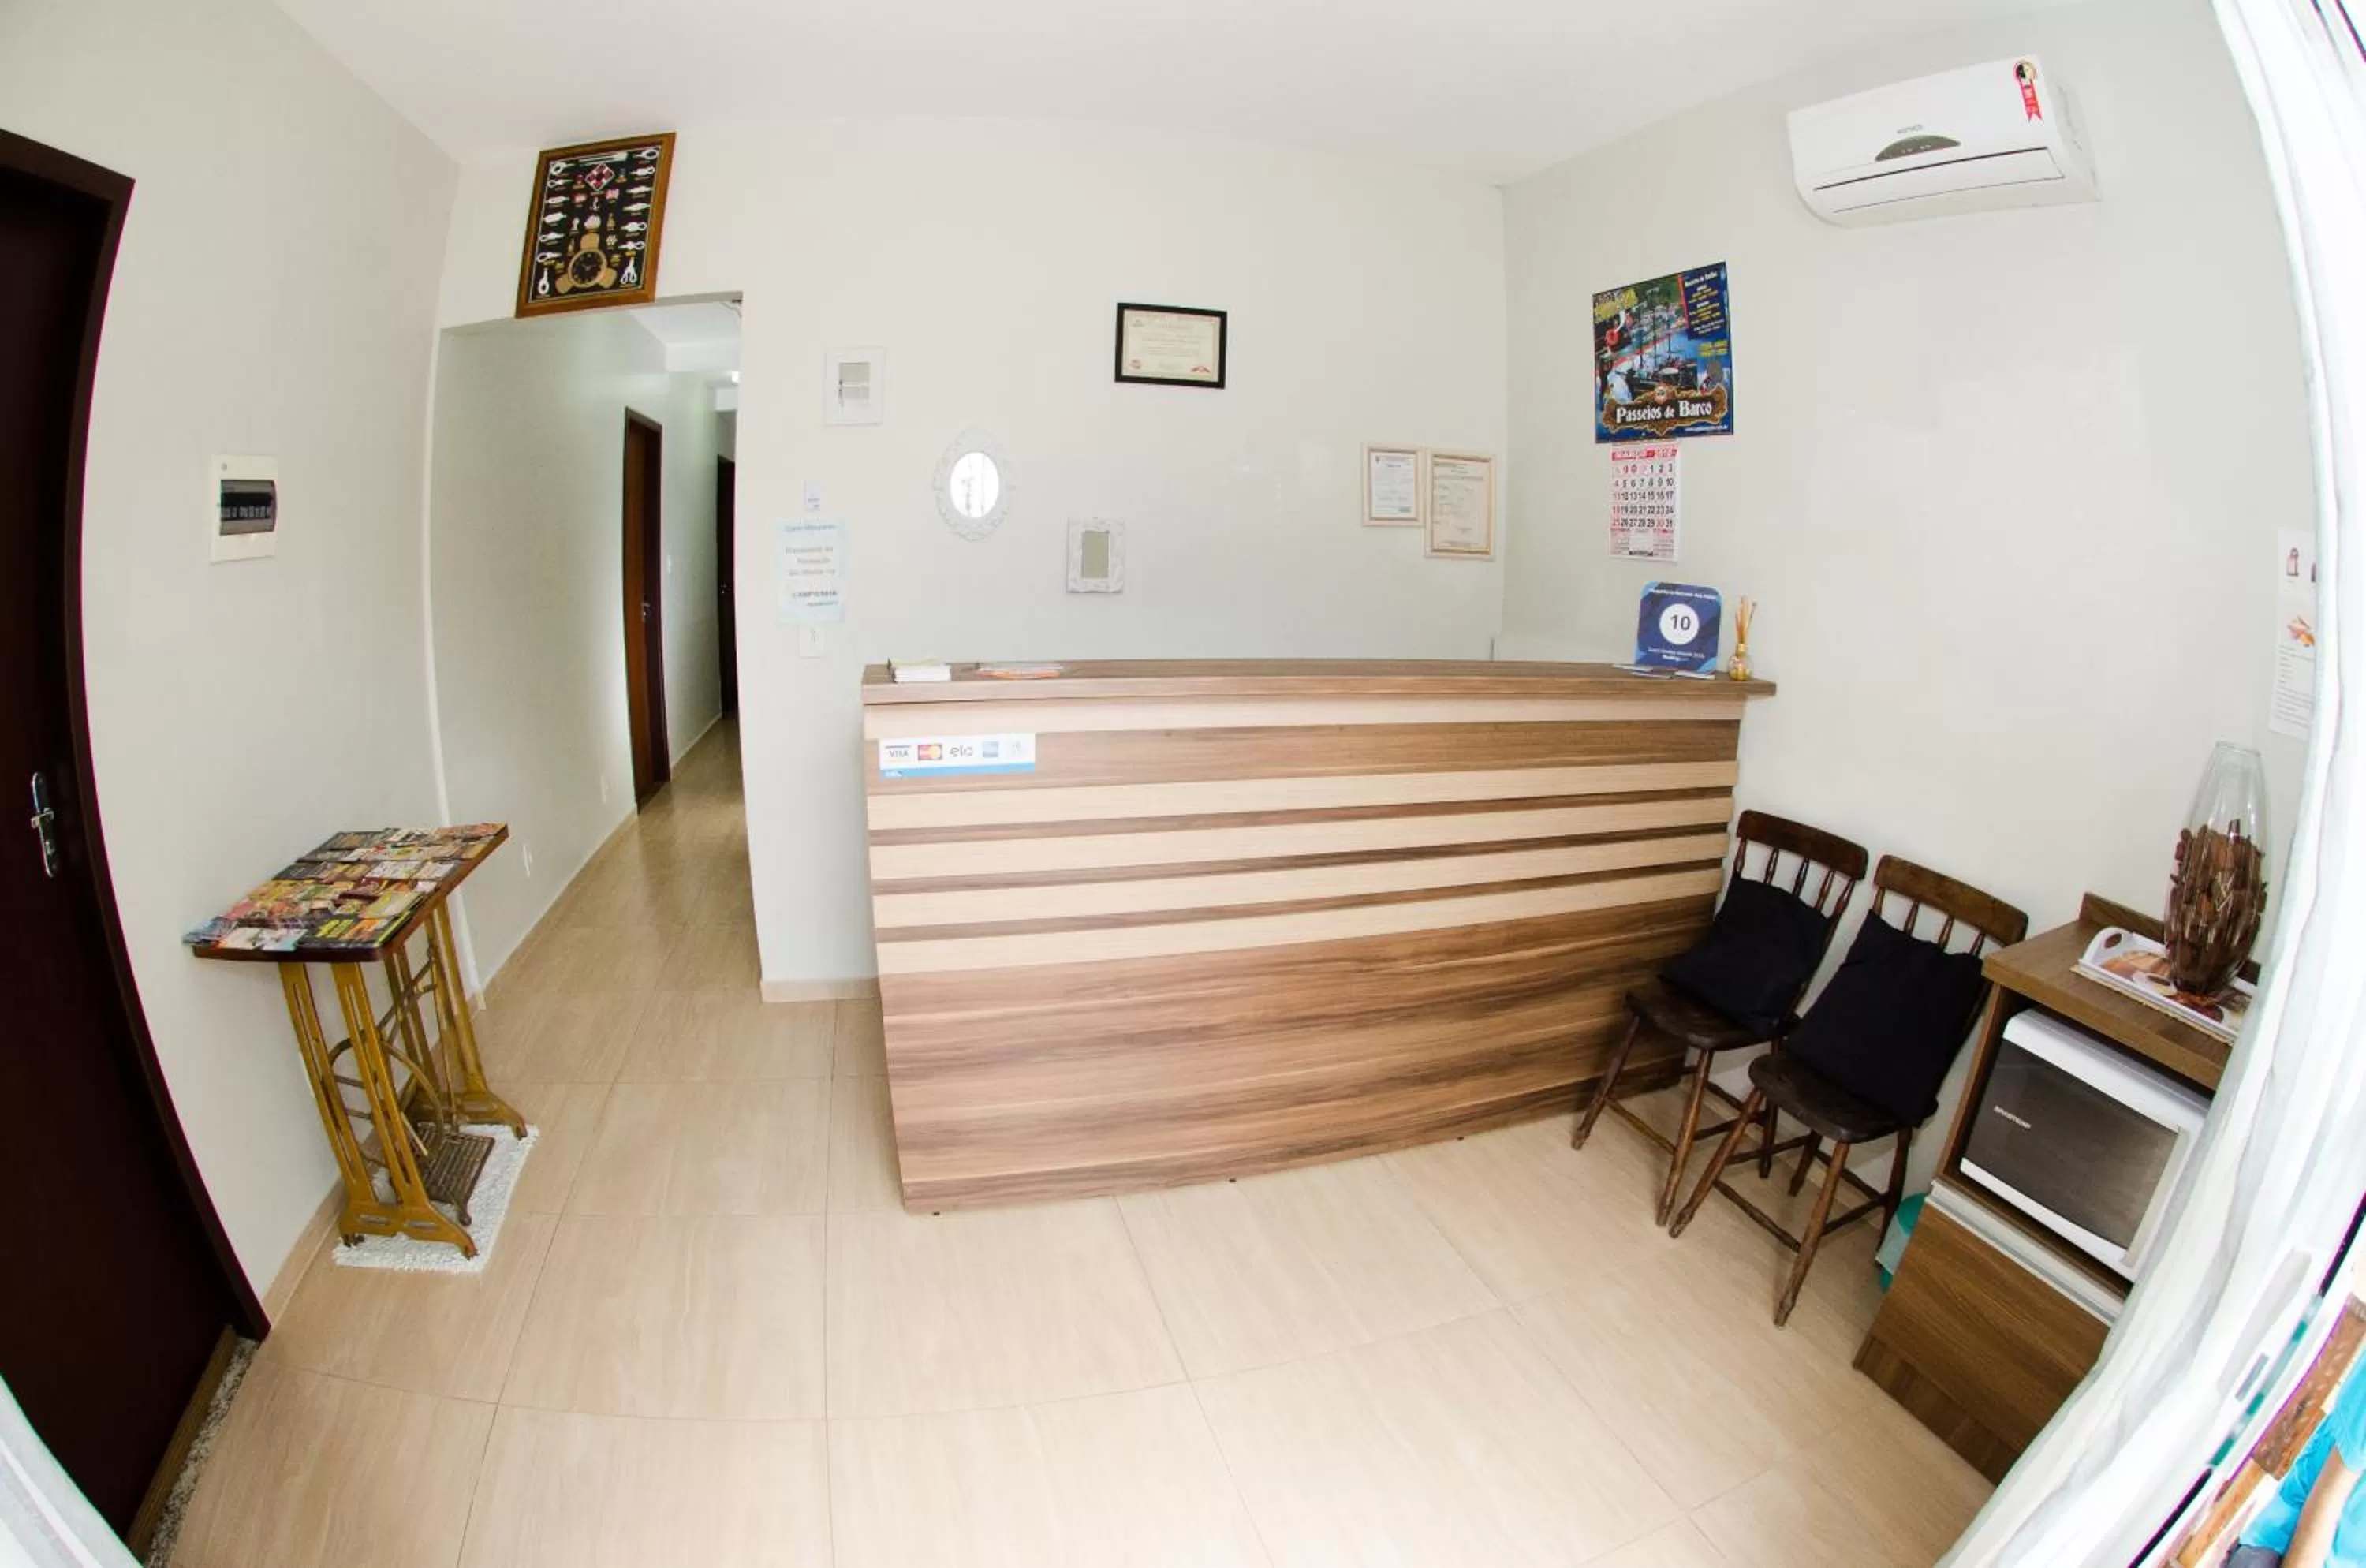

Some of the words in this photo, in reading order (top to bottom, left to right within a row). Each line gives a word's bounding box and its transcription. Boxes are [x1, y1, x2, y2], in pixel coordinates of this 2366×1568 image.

[1616, 406, 1662, 424] Passeios
[1663, 405, 1675, 419] de
[1678, 400, 1713, 418] Barco
[1630, 479, 1636, 487] 6
[1657, 477, 1663, 487] 9
[1666, 477, 1674, 487] 10
[1621, 491, 1629, 501] 12
[1629, 491, 1637, 501] 13
[1638, 491, 1646, 500] 14
[1648, 491, 1655, 501] 15
[1656, 491, 1664, 500] 16
[1666, 491, 1674, 500] 17
[1621, 506, 1629, 514] 19
[1629, 506, 1637, 514] 20
[1638, 506, 1646, 514] 21
[1647, 505, 1655, 514] 22
[1656, 505, 1664, 514] 23
[1665, 505, 1674, 514] 24
[1621, 518, 1628, 528] 26
[1629, 518, 1637, 528] 27
[1638, 518, 1646, 528] 28
[1647, 518, 1655, 528] 29
[1666, 518, 1673, 528] 31
[1670, 614, 1692, 631] 10
[889, 749, 909, 758] VISA
[949, 745, 973, 758] elo
